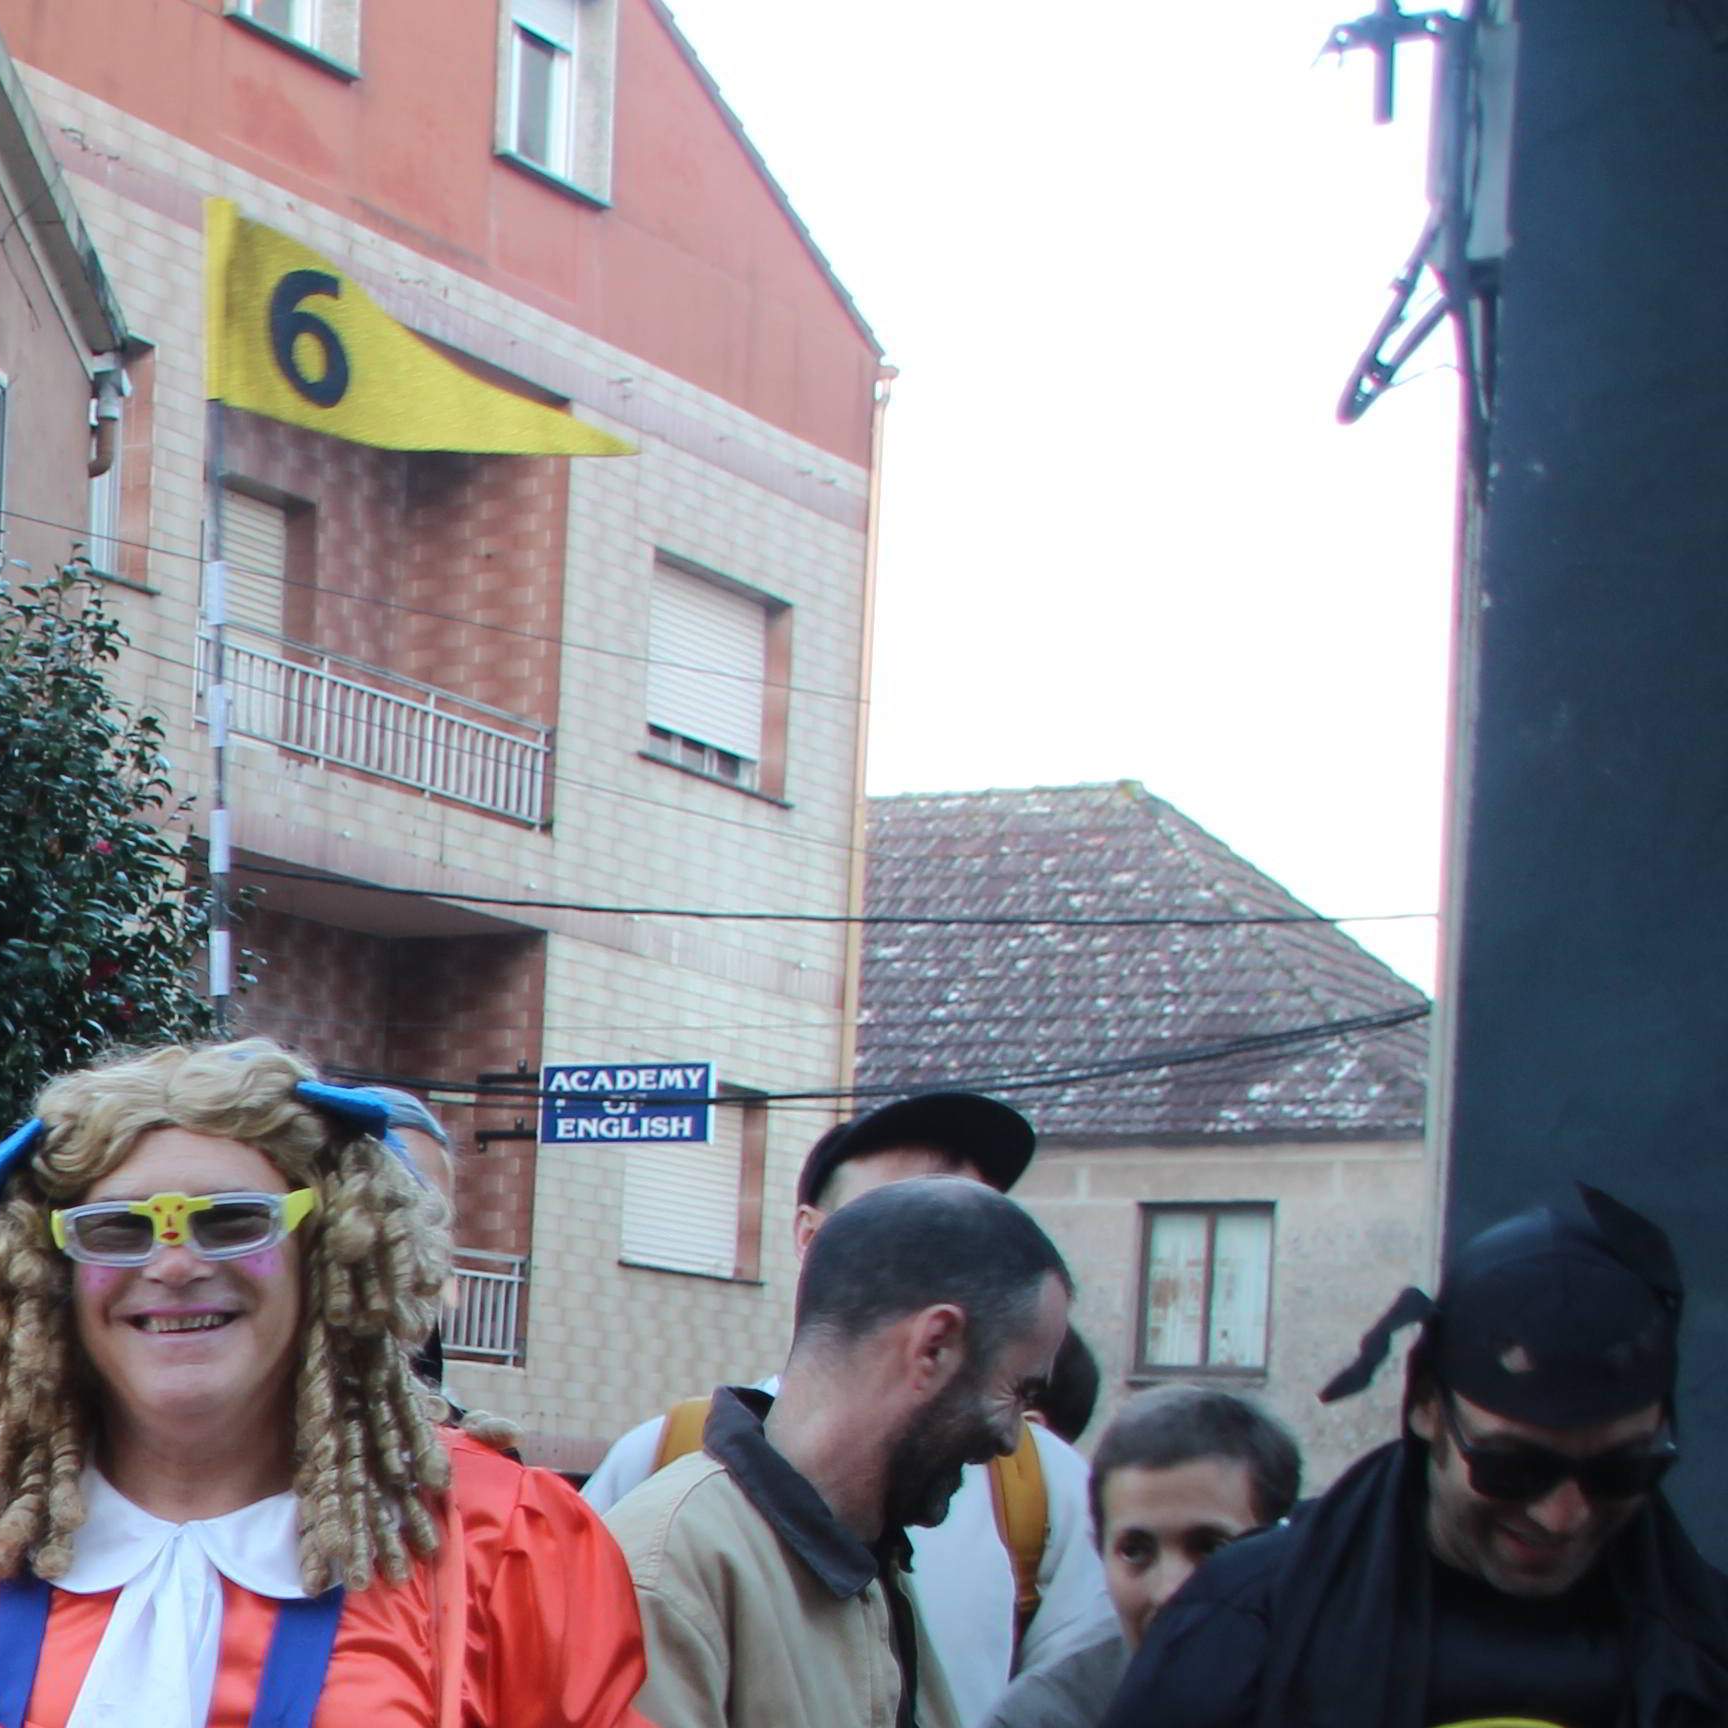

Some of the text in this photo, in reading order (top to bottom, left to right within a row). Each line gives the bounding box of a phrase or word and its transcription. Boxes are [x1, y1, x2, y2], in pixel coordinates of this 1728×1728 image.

[270, 269, 350, 409] 6
[548, 1067, 705, 1092] ACADEMY
[555, 1116, 692, 1139] ENGLISH
